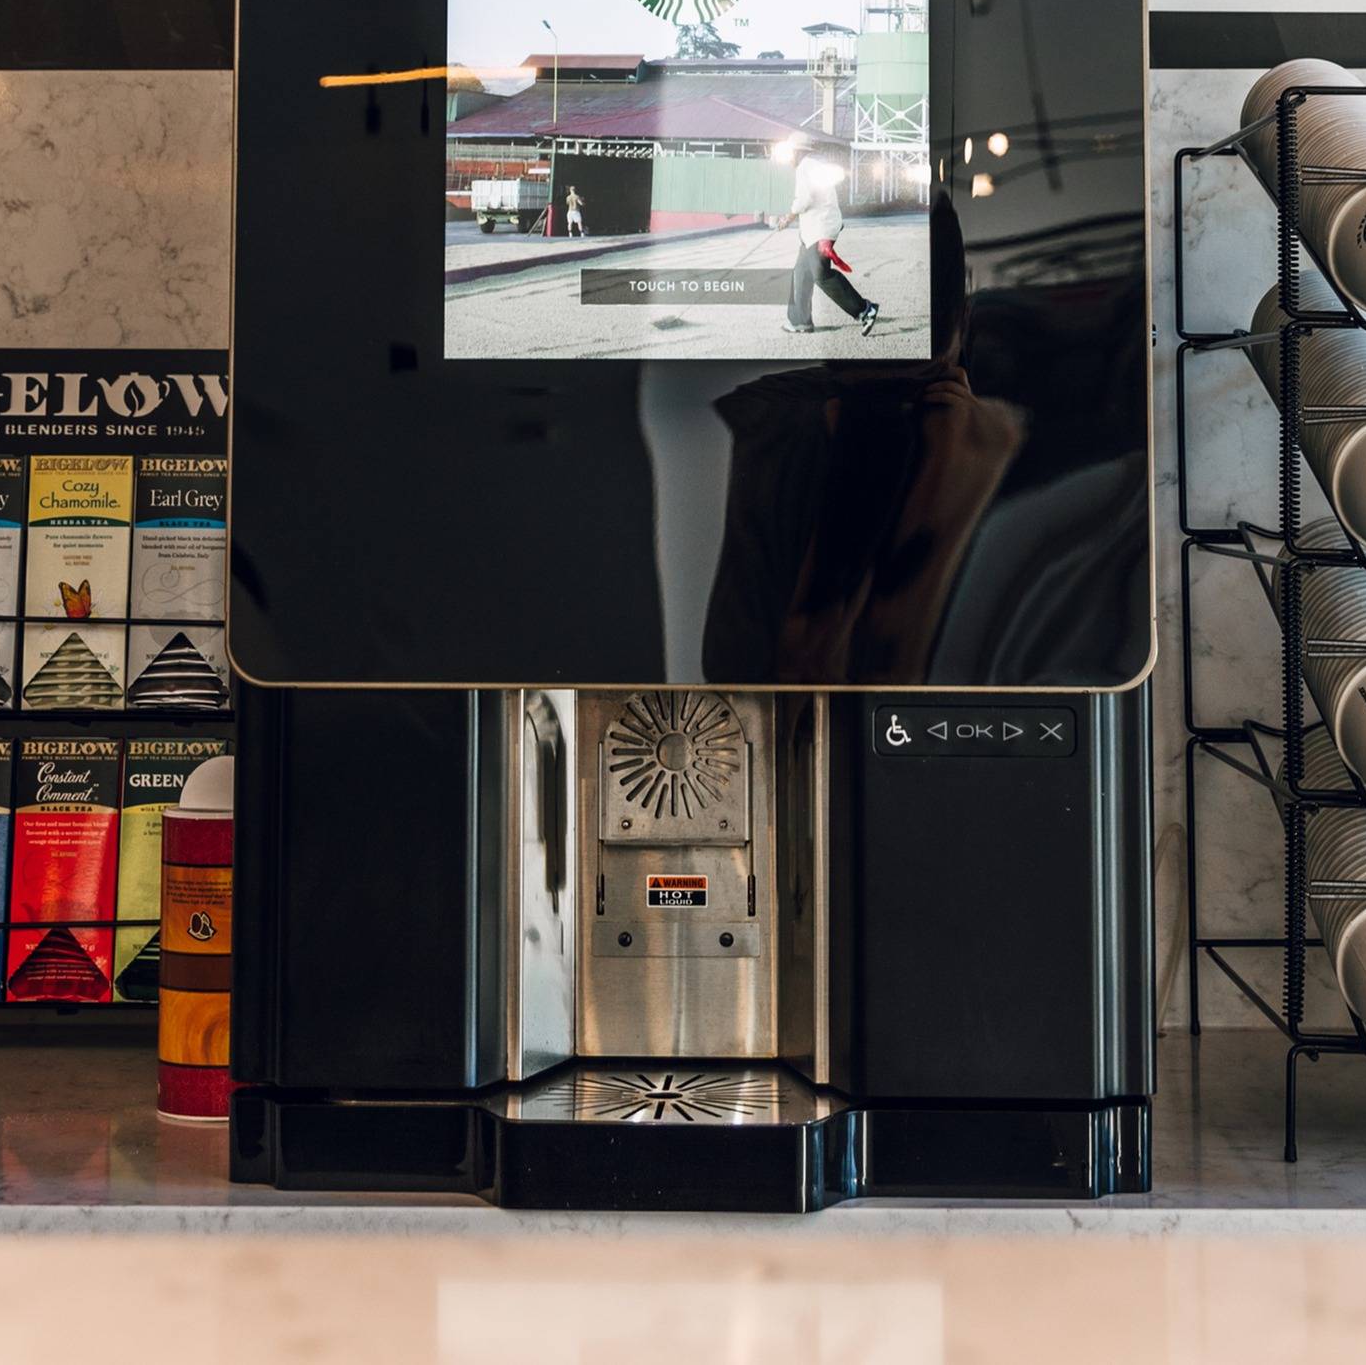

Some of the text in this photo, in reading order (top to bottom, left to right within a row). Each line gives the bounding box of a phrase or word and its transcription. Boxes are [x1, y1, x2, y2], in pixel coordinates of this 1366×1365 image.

[733, 18, 749, 27] TM
[629, 280, 745, 292] TOUCH TO BEGIN
[5, 424, 98, 435] BLENDERS
[106, 424, 157, 436] SINCE
[34, 458, 129, 471] BIGELOW
[140, 458, 227, 472] BIGELOW
[62, 479, 99, 498] Cozy
[150, 489, 223, 511] Earl Grey
[956, 724, 993, 738] OK
[22, 741, 117, 755] BIGELOW
[129, 741, 224, 755] BIGELOW
[129, 773, 184, 787] GREEN
[664, 877, 704, 887] WARNING
[659, 891, 693, 899] HOT
